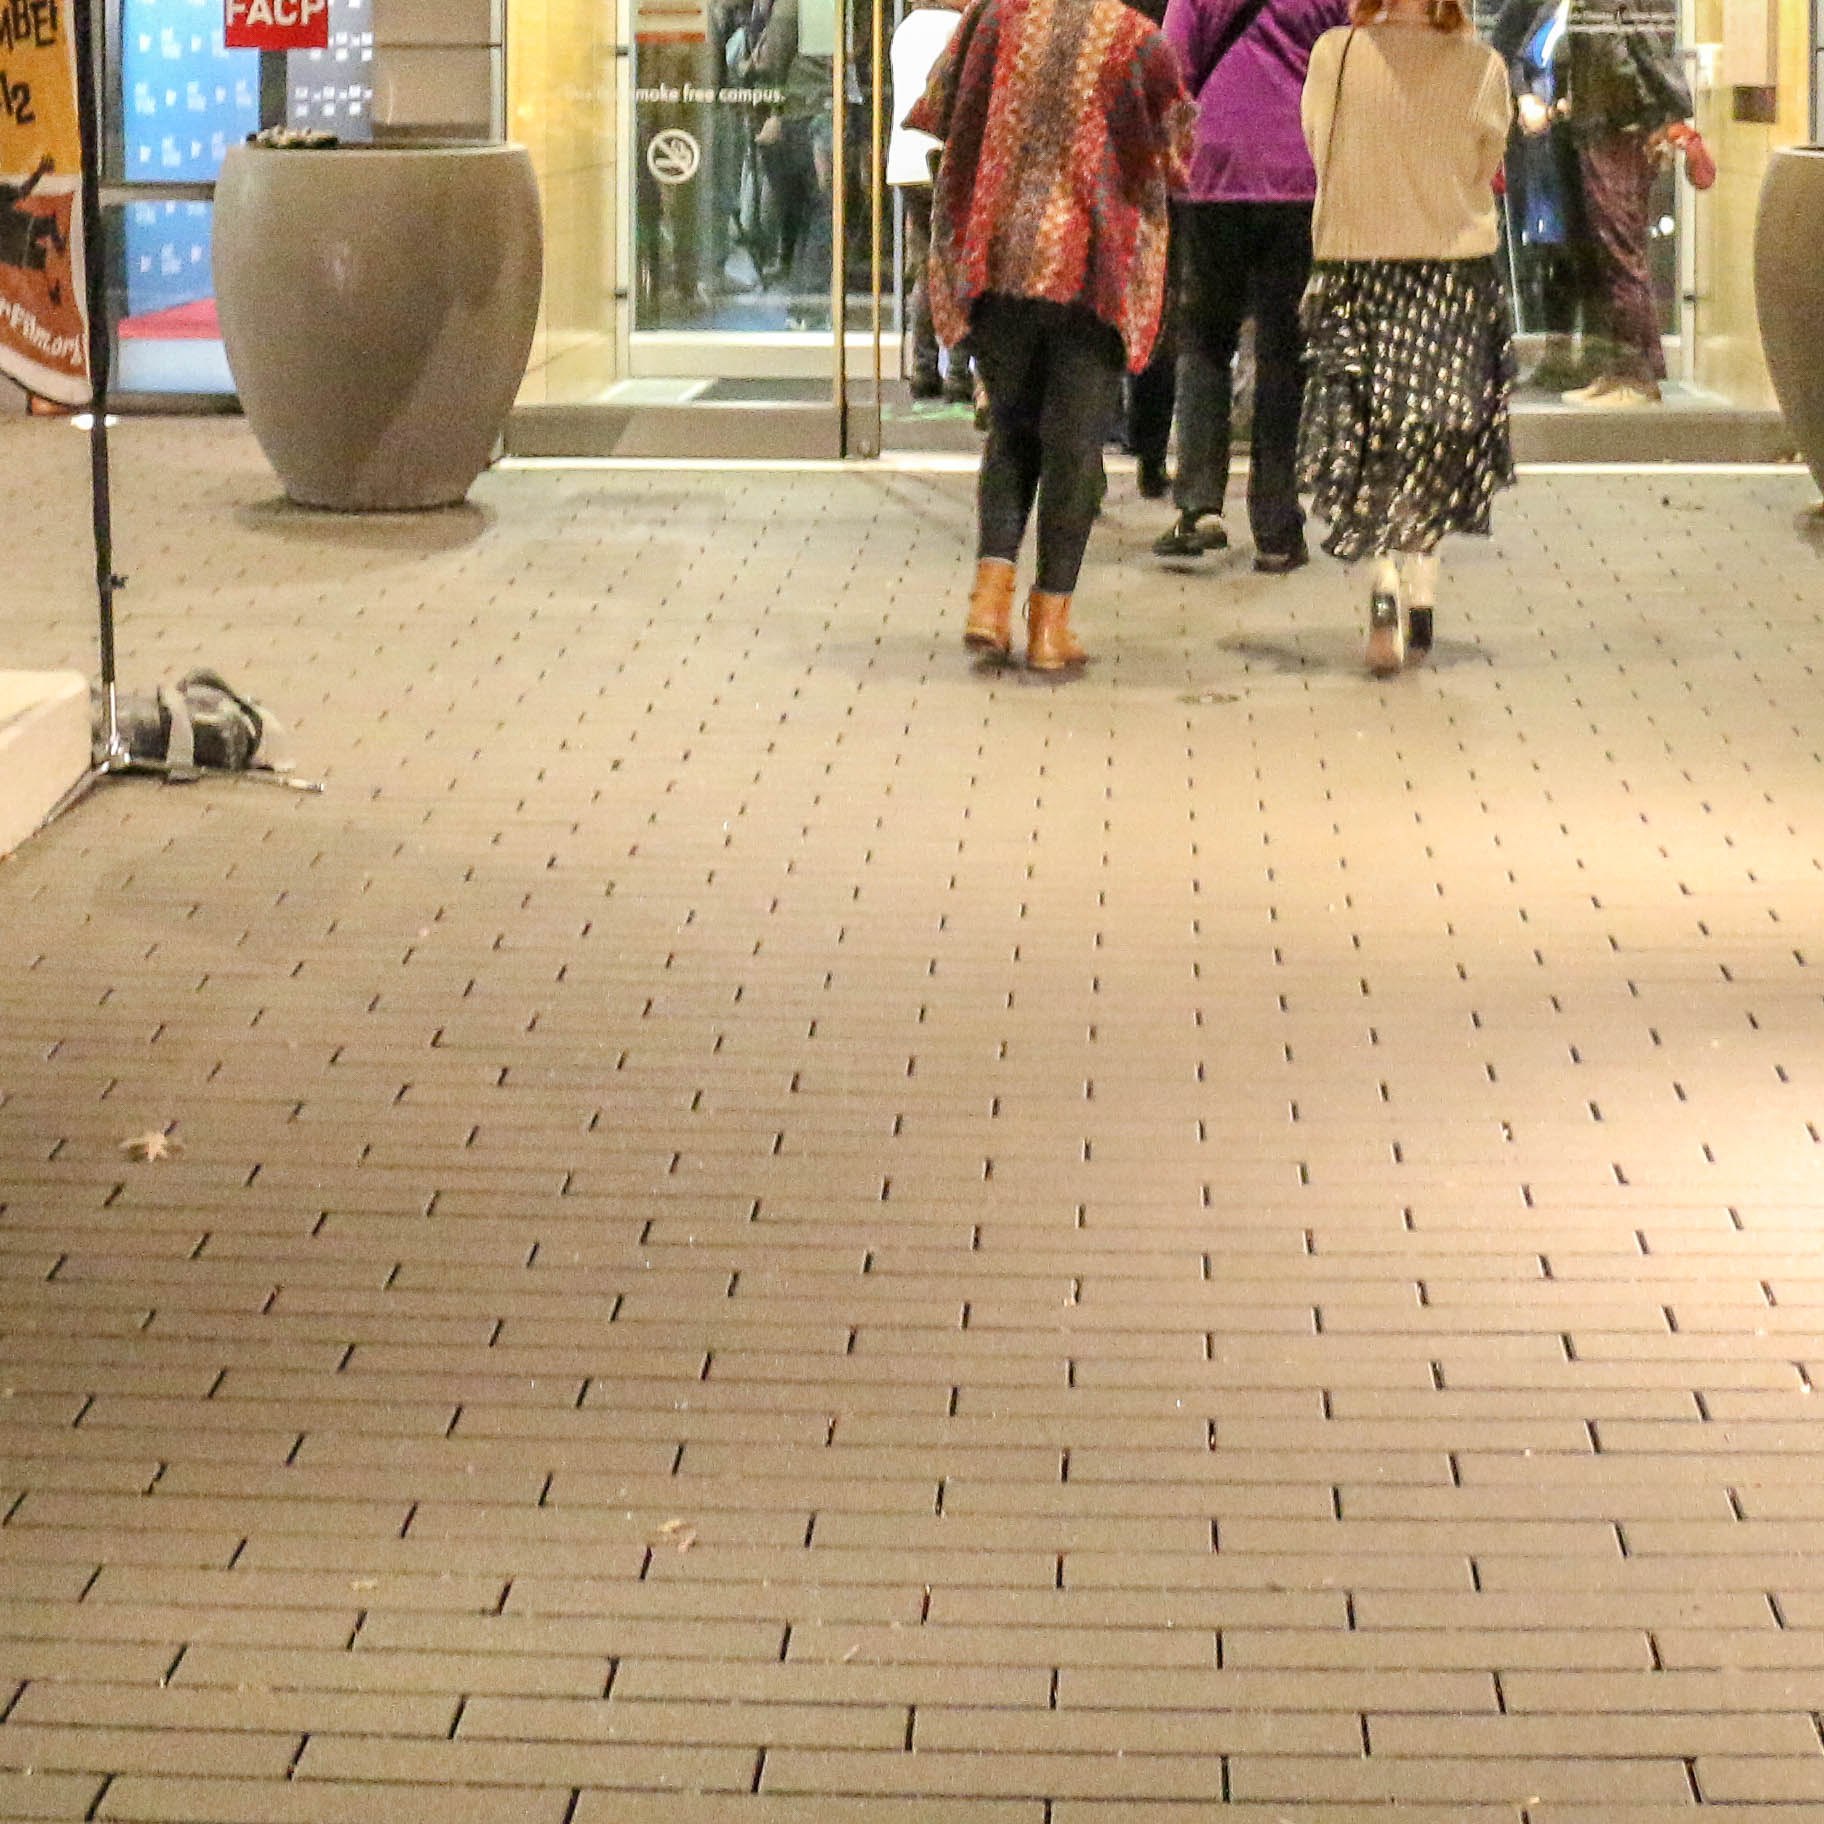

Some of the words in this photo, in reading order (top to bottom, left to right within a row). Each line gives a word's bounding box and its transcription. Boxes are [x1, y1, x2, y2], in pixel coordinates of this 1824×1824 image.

[635, 82, 680, 103] moke
[683, 81, 715, 103] free
[718, 87, 786, 108] campus.
